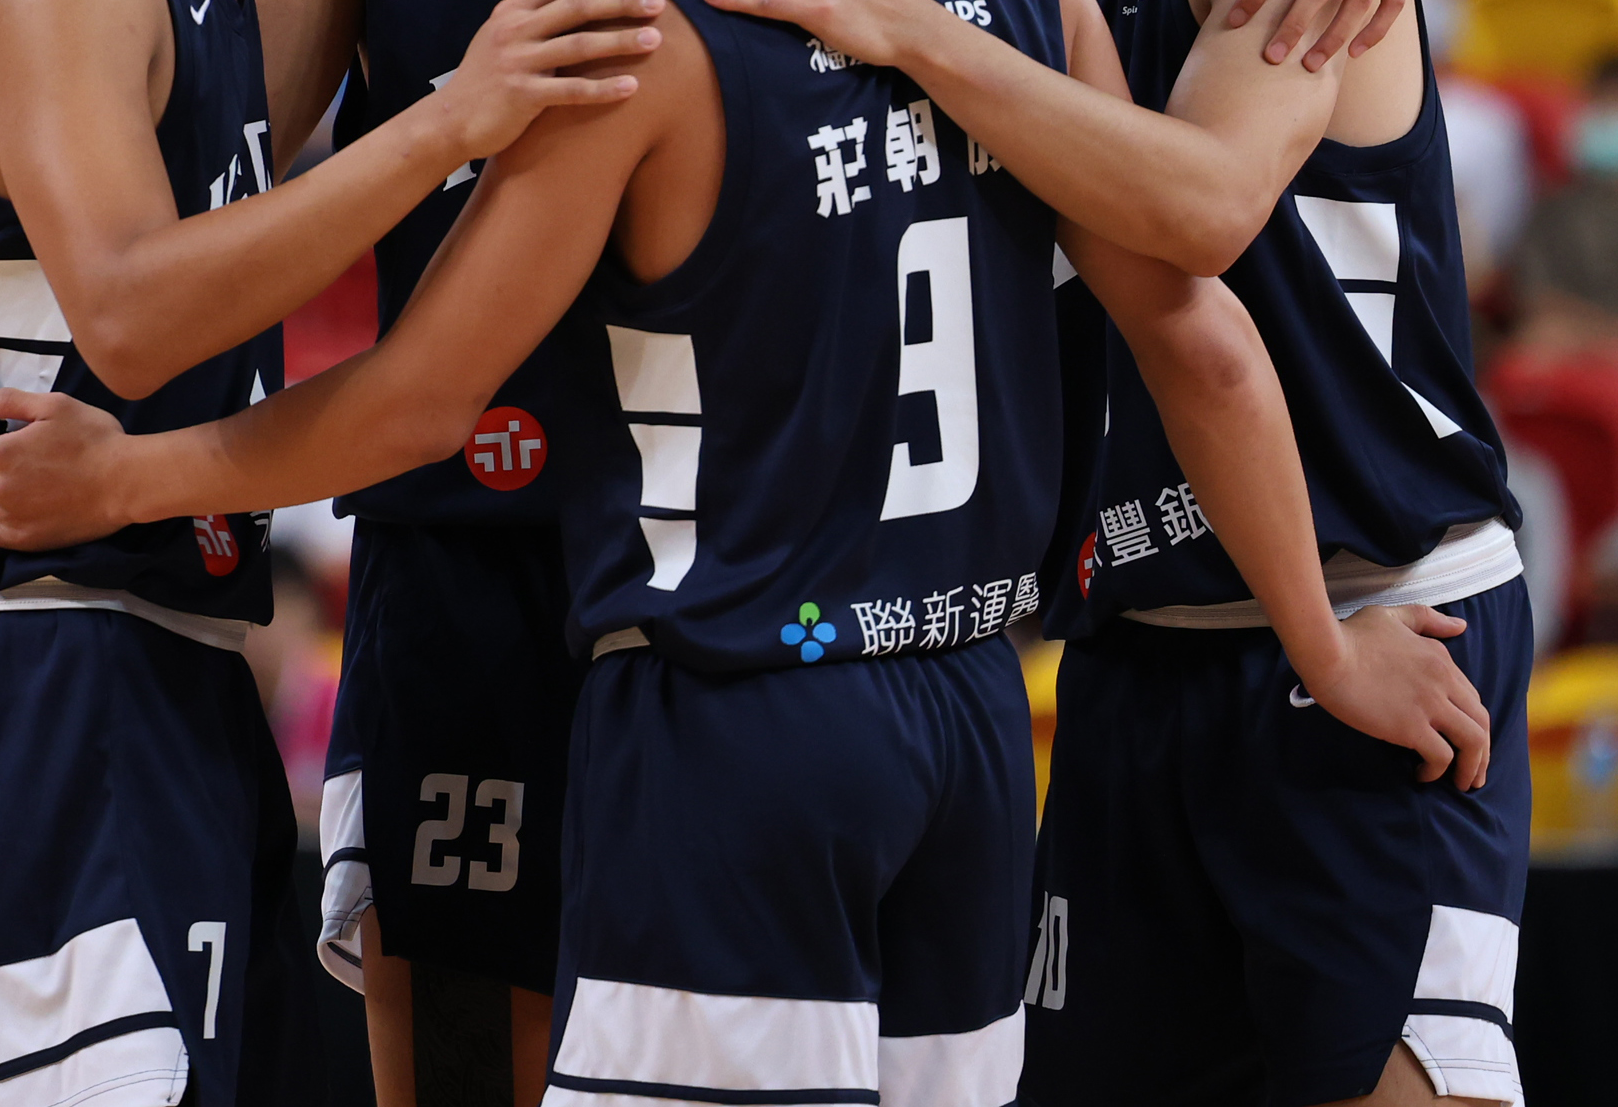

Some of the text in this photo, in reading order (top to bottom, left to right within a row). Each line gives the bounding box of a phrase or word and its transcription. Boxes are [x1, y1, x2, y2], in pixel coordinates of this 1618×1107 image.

[879, 216, 980, 522] 9
[1093, 483, 1214, 568] 豐銀
[411, 773, 525, 892] 23
[188, 921, 227, 1039] 7
